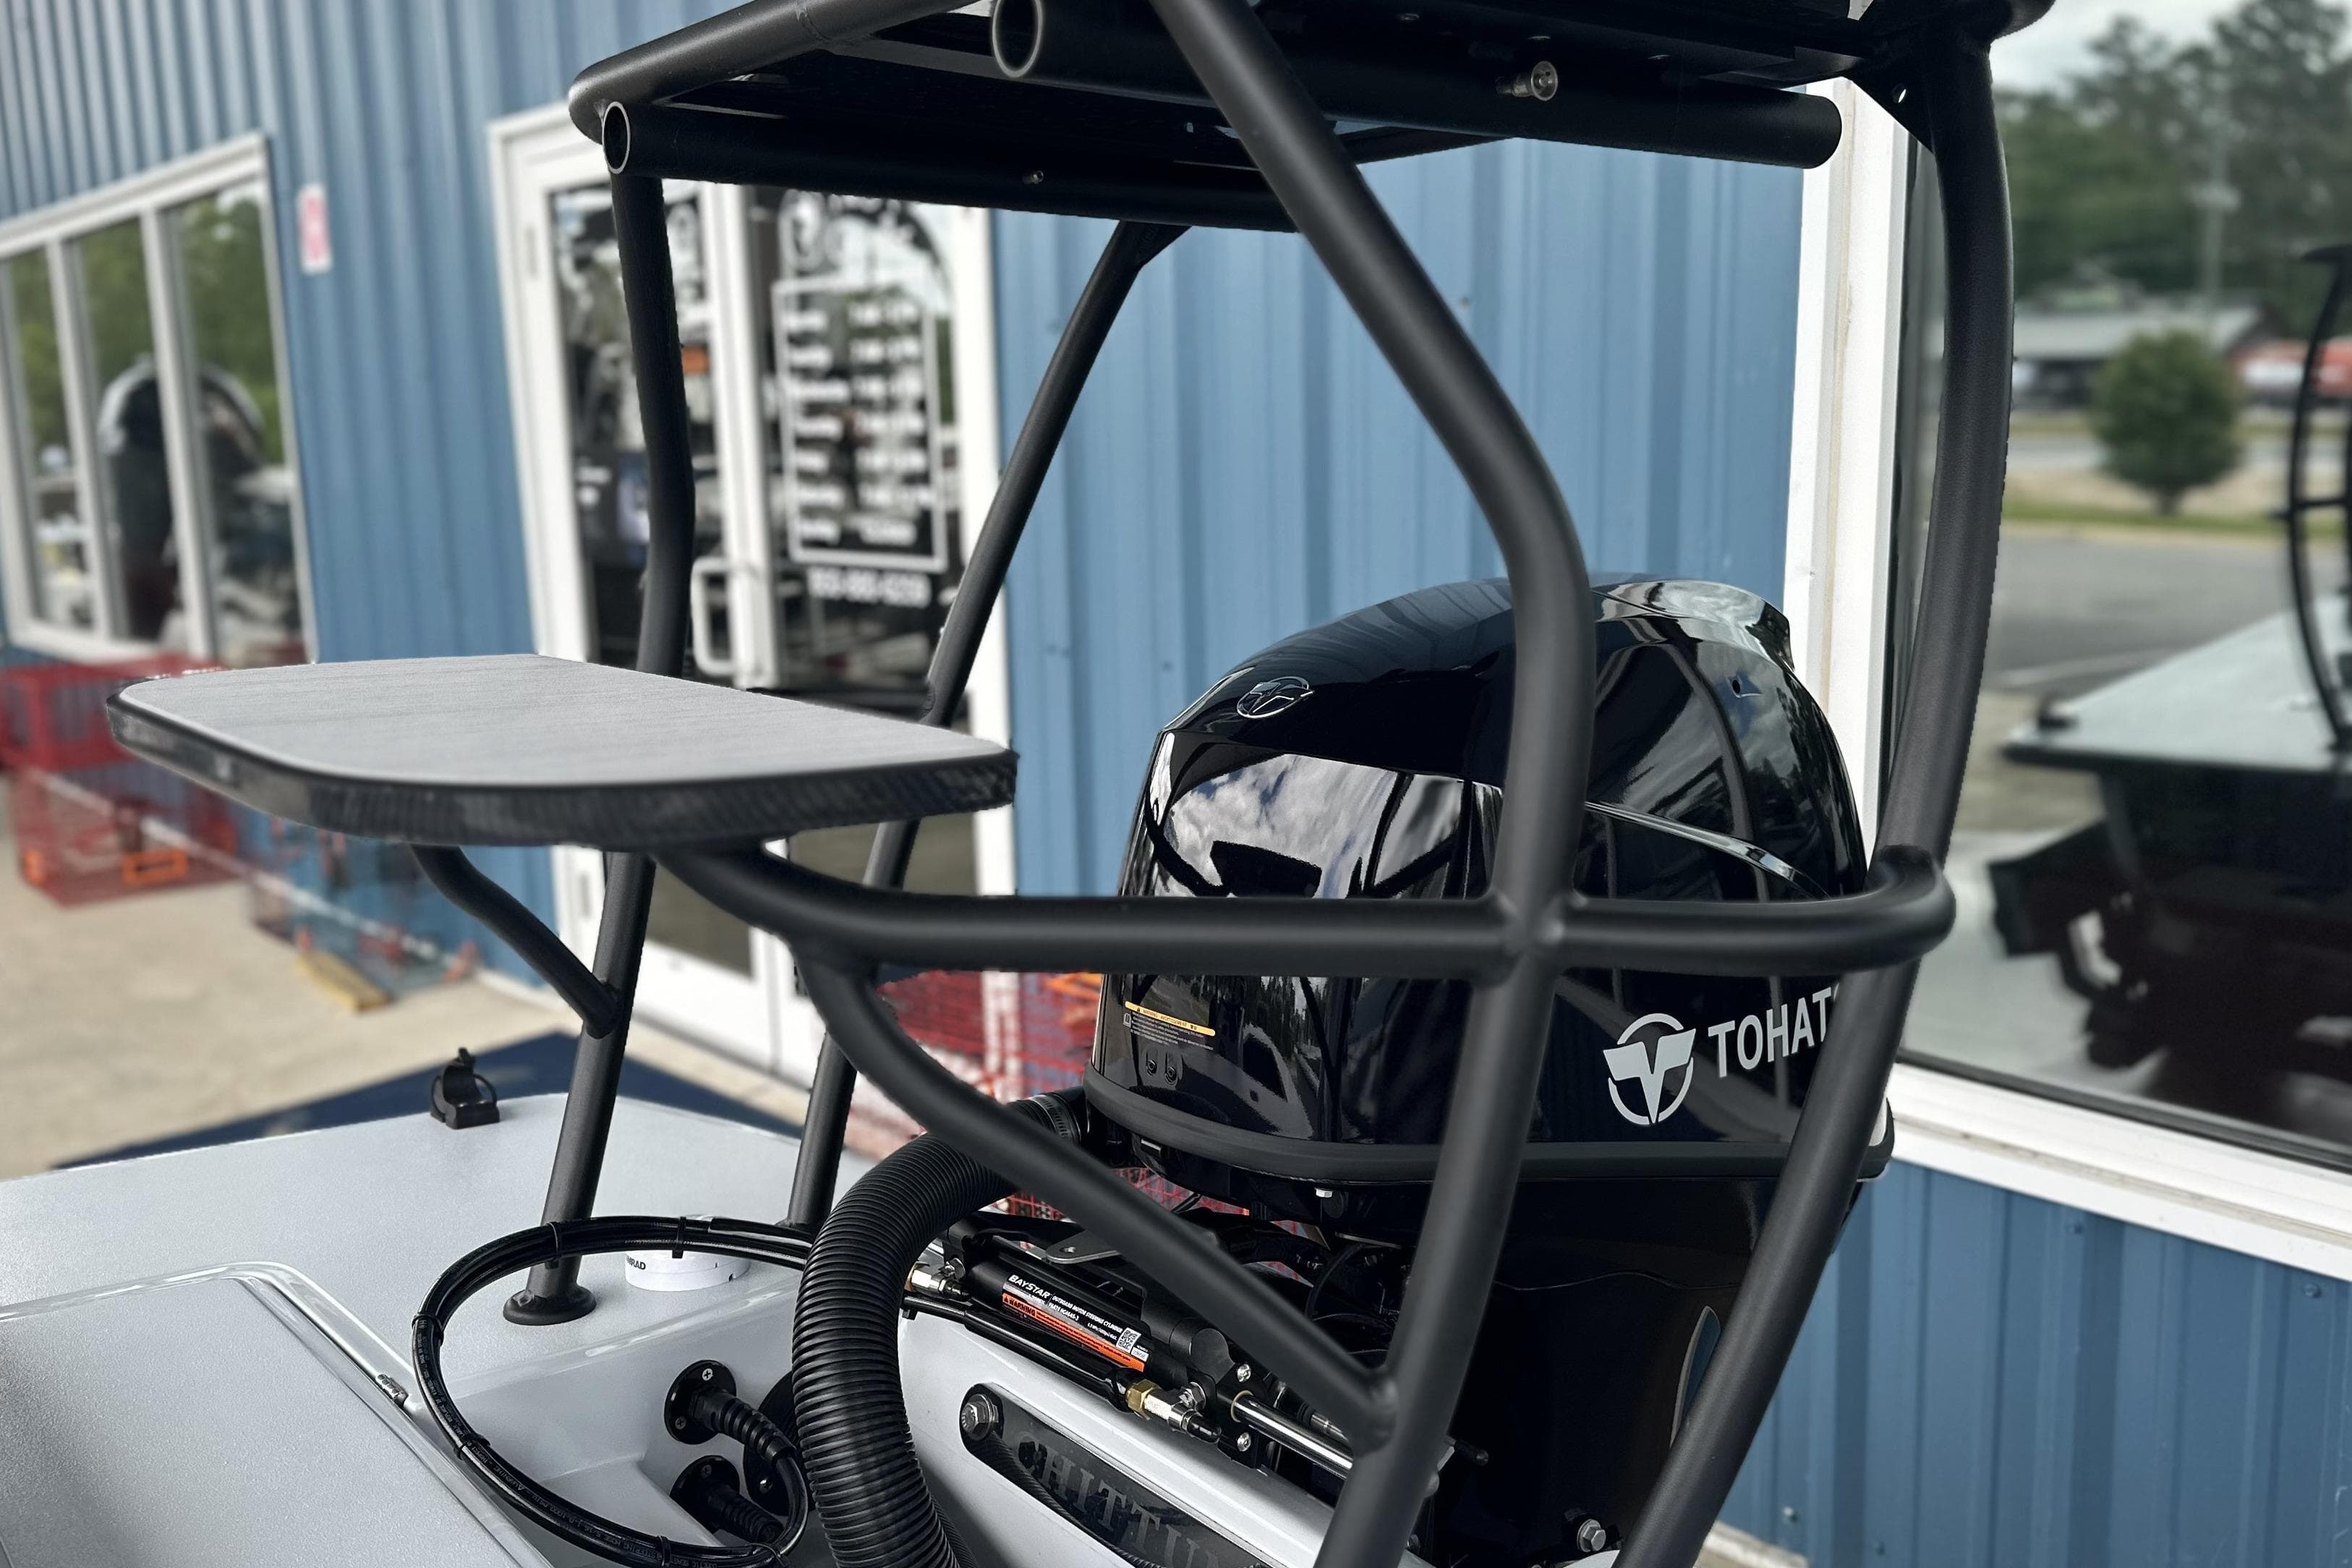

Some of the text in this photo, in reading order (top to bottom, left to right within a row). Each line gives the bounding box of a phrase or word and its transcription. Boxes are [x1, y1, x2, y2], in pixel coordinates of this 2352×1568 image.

[1708, 983, 1839, 1078] TOHAT
[1008, 1274, 1051, 1298] BAYSTAR
[1015, 1431, 1222, 1568] CHITTU
